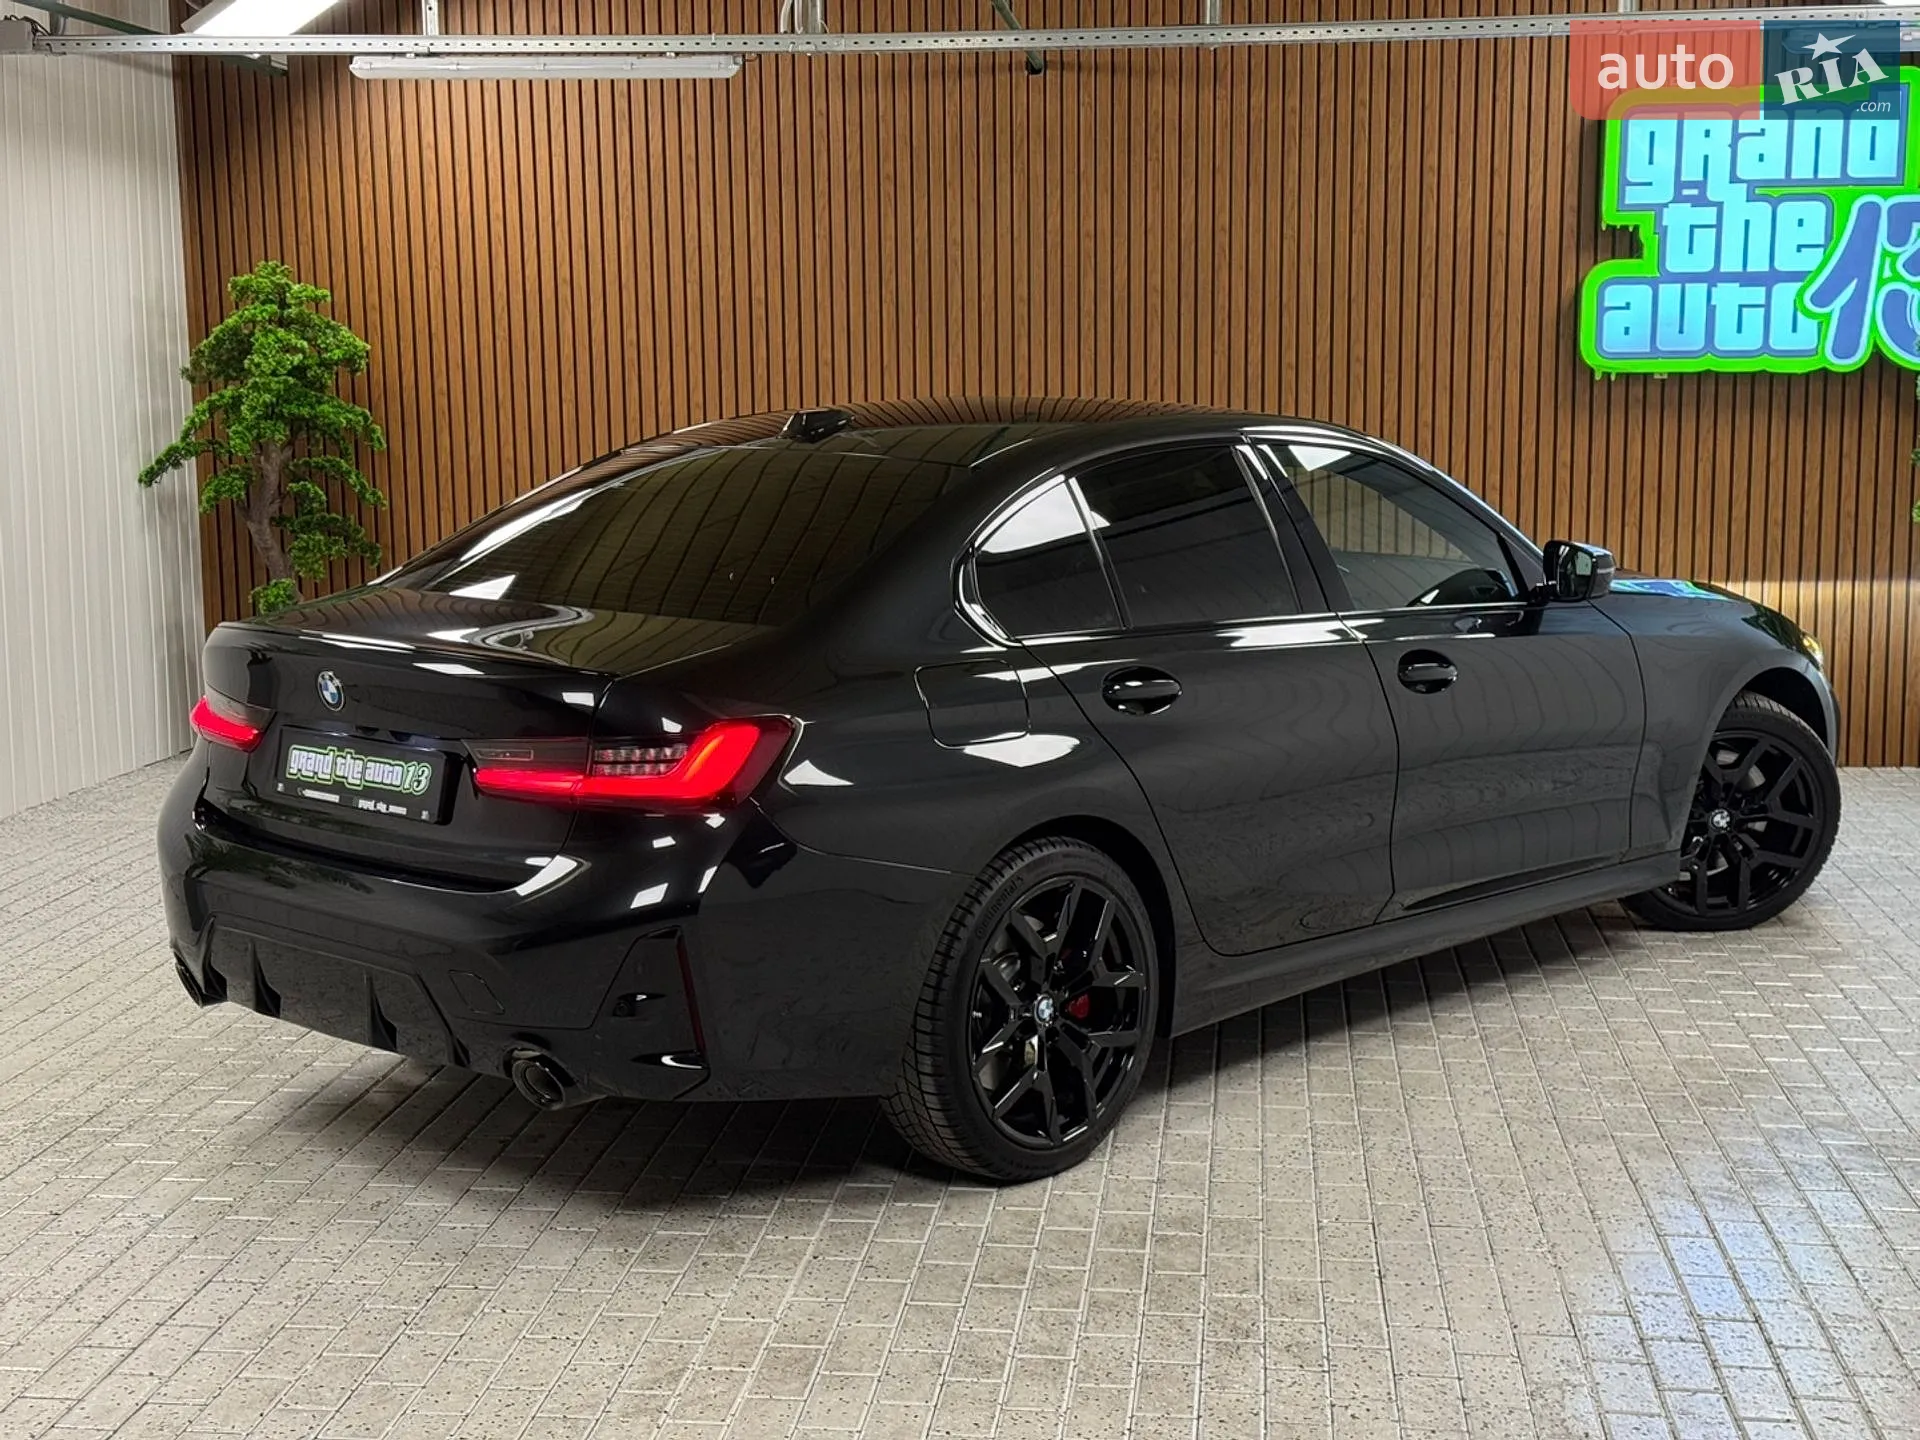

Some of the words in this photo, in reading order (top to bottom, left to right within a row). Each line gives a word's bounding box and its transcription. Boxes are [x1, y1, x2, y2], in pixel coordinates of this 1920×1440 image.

[1662, 186, 1827, 273] the
[1602, 282, 1819, 352] auto
[336, 752, 364, 785] the
